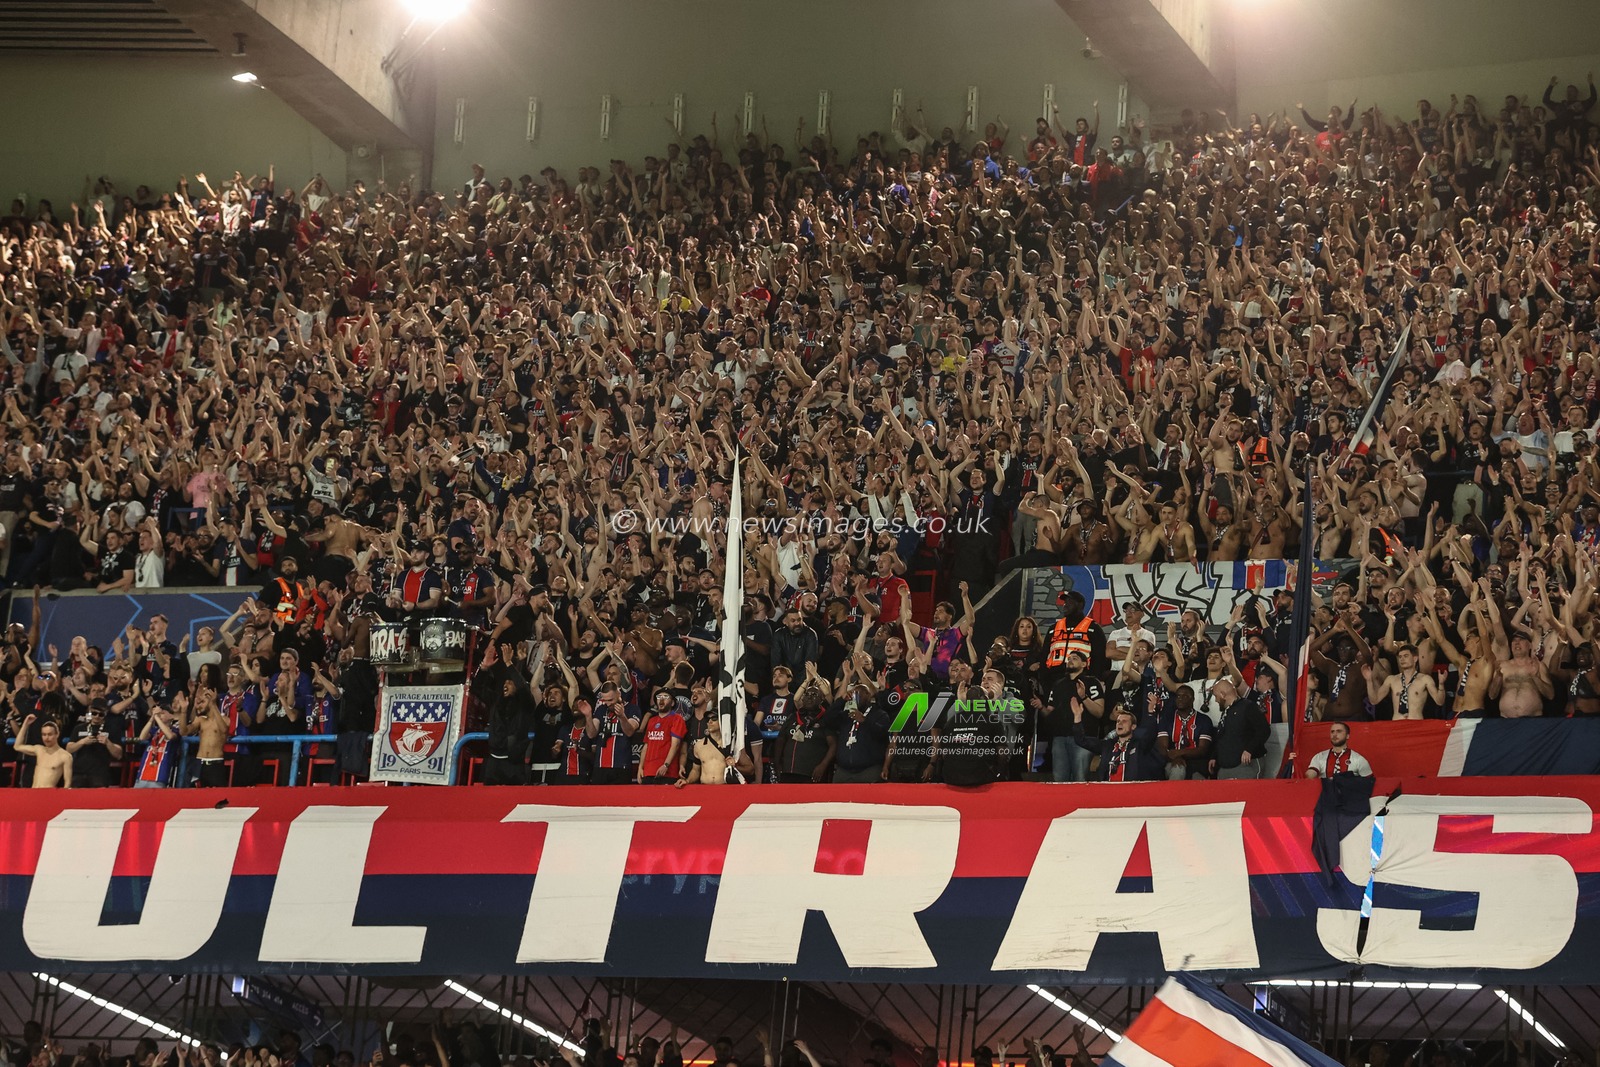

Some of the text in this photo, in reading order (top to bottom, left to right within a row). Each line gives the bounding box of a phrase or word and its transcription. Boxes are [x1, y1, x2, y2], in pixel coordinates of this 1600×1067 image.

[394, 693, 421, 701] VIRAGE
[380, 753, 445, 772] 19 91
[399, 767, 422, 775] PARIS
[22, 794, 1594, 971] ULTRAS
